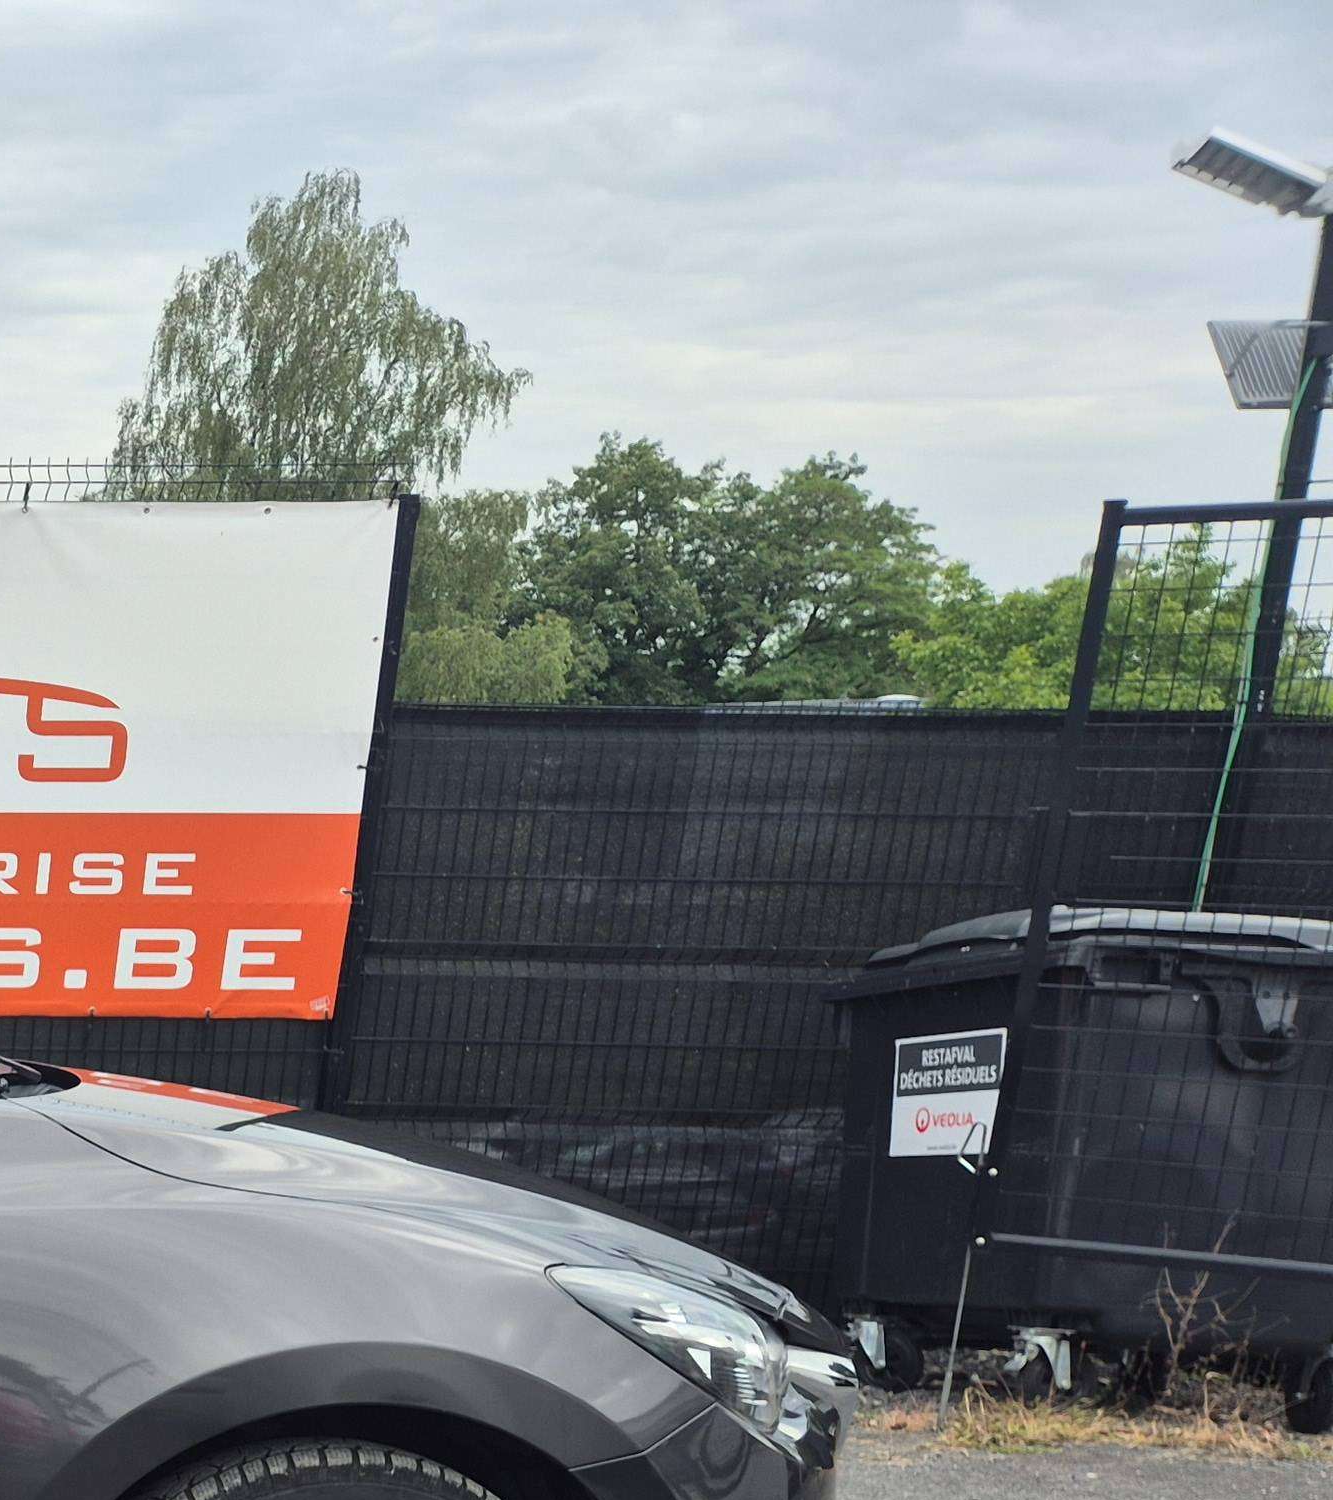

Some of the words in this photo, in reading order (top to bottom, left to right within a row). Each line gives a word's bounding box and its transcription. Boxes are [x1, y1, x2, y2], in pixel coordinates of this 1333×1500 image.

[921, 1044, 976, 1068] RESTAFVAL
[899, 1068, 944, 1091] DÉCHETS
[944, 1064, 998, 1087] RÉSIDUELS
[932, 1111, 974, 1128] VEOLIA
